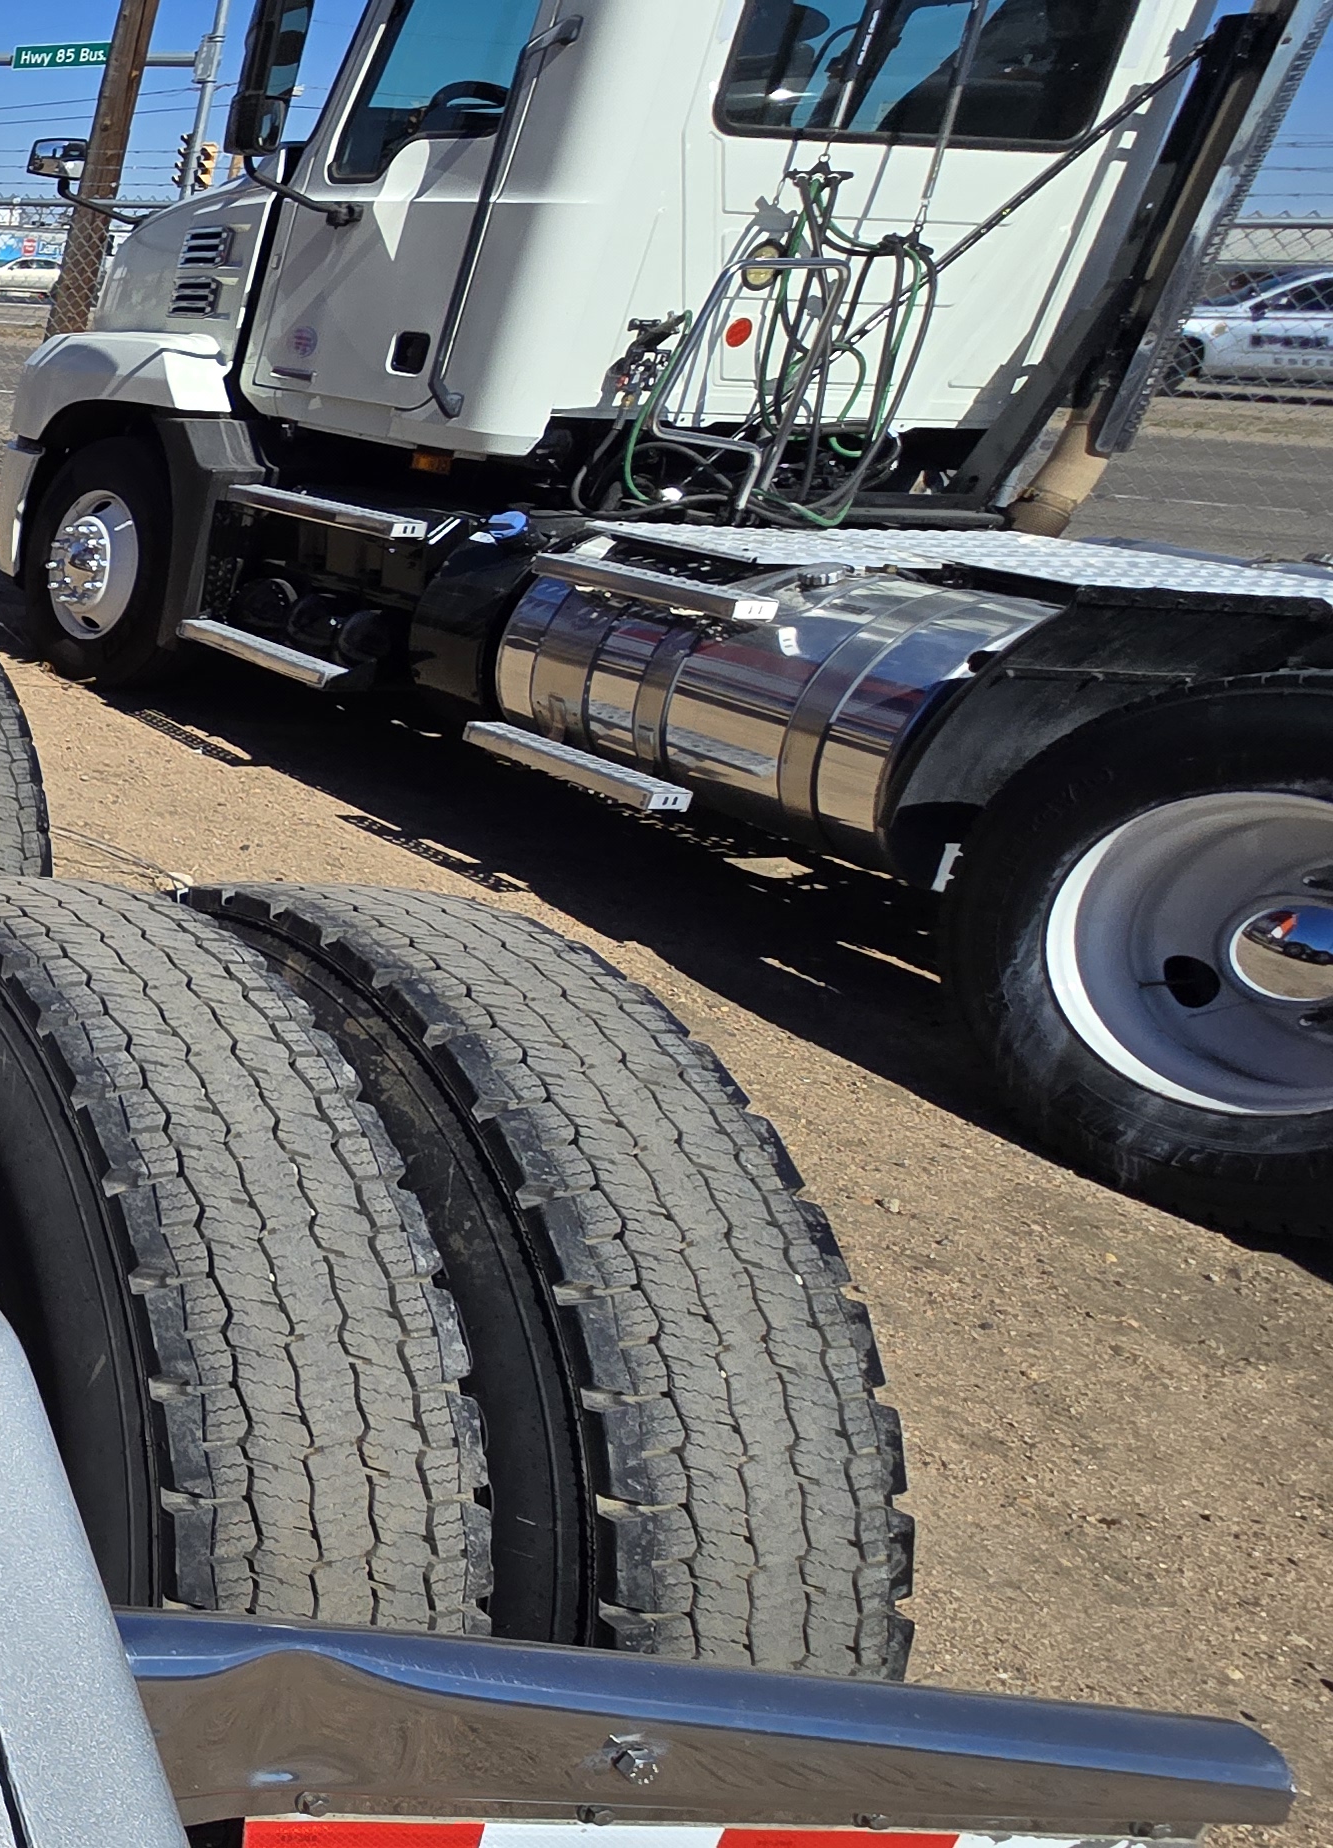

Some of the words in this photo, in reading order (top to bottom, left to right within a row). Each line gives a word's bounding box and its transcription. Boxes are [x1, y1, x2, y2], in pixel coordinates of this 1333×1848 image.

[20, 50, 53, 67] Hwy
[55, 48, 76, 63] 85
[79, 47, 107, 62] Bus.
